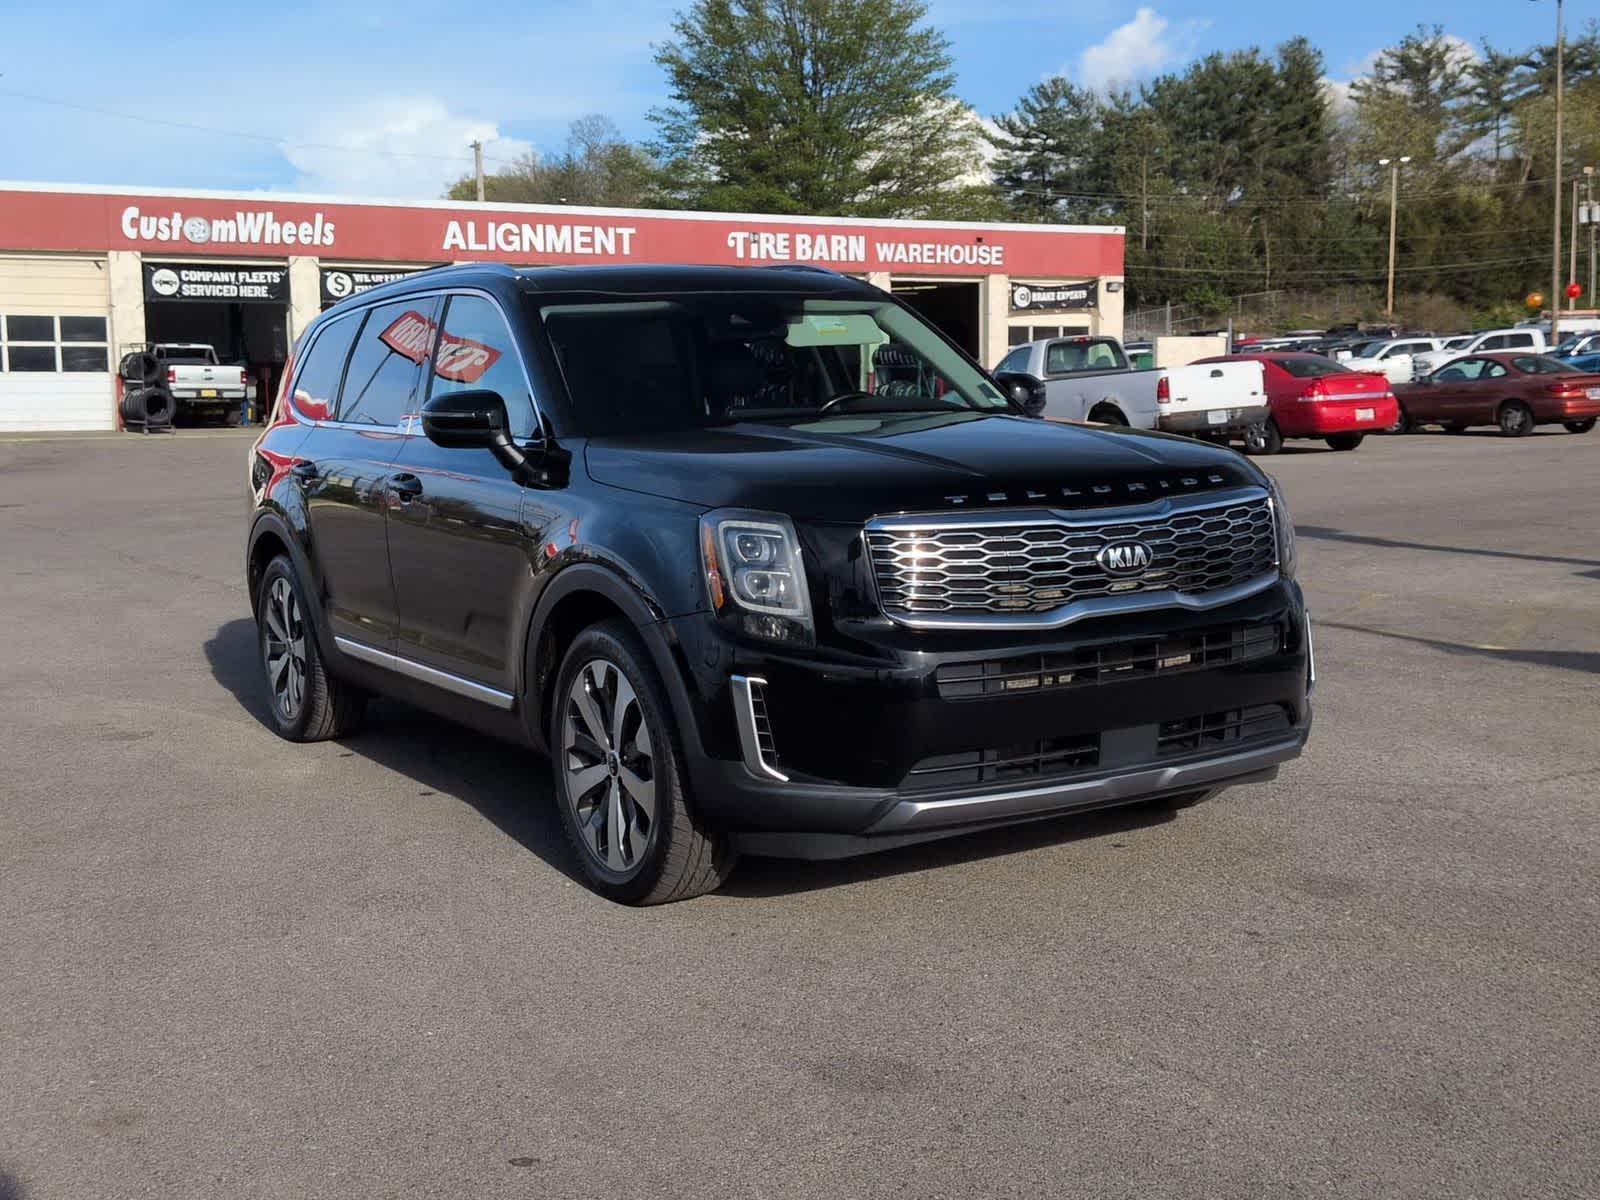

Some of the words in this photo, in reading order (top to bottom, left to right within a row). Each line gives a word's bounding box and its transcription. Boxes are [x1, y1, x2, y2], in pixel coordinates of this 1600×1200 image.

[442, 220, 636, 255] ALIGNMENT
[795, 233, 865, 263] BARN
[876, 242, 1004, 266] WAREHOUSE
[180, 269, 236, 282] COMPANY
[239, 271, 281, 283] FLEETS
[180, 284, 237, 297] SERVICED
[240, 285, 269, 297] HERE
[944, 474, 1224, 504] TELLURIDE
[1108, 545, 1147, 568] KIA
